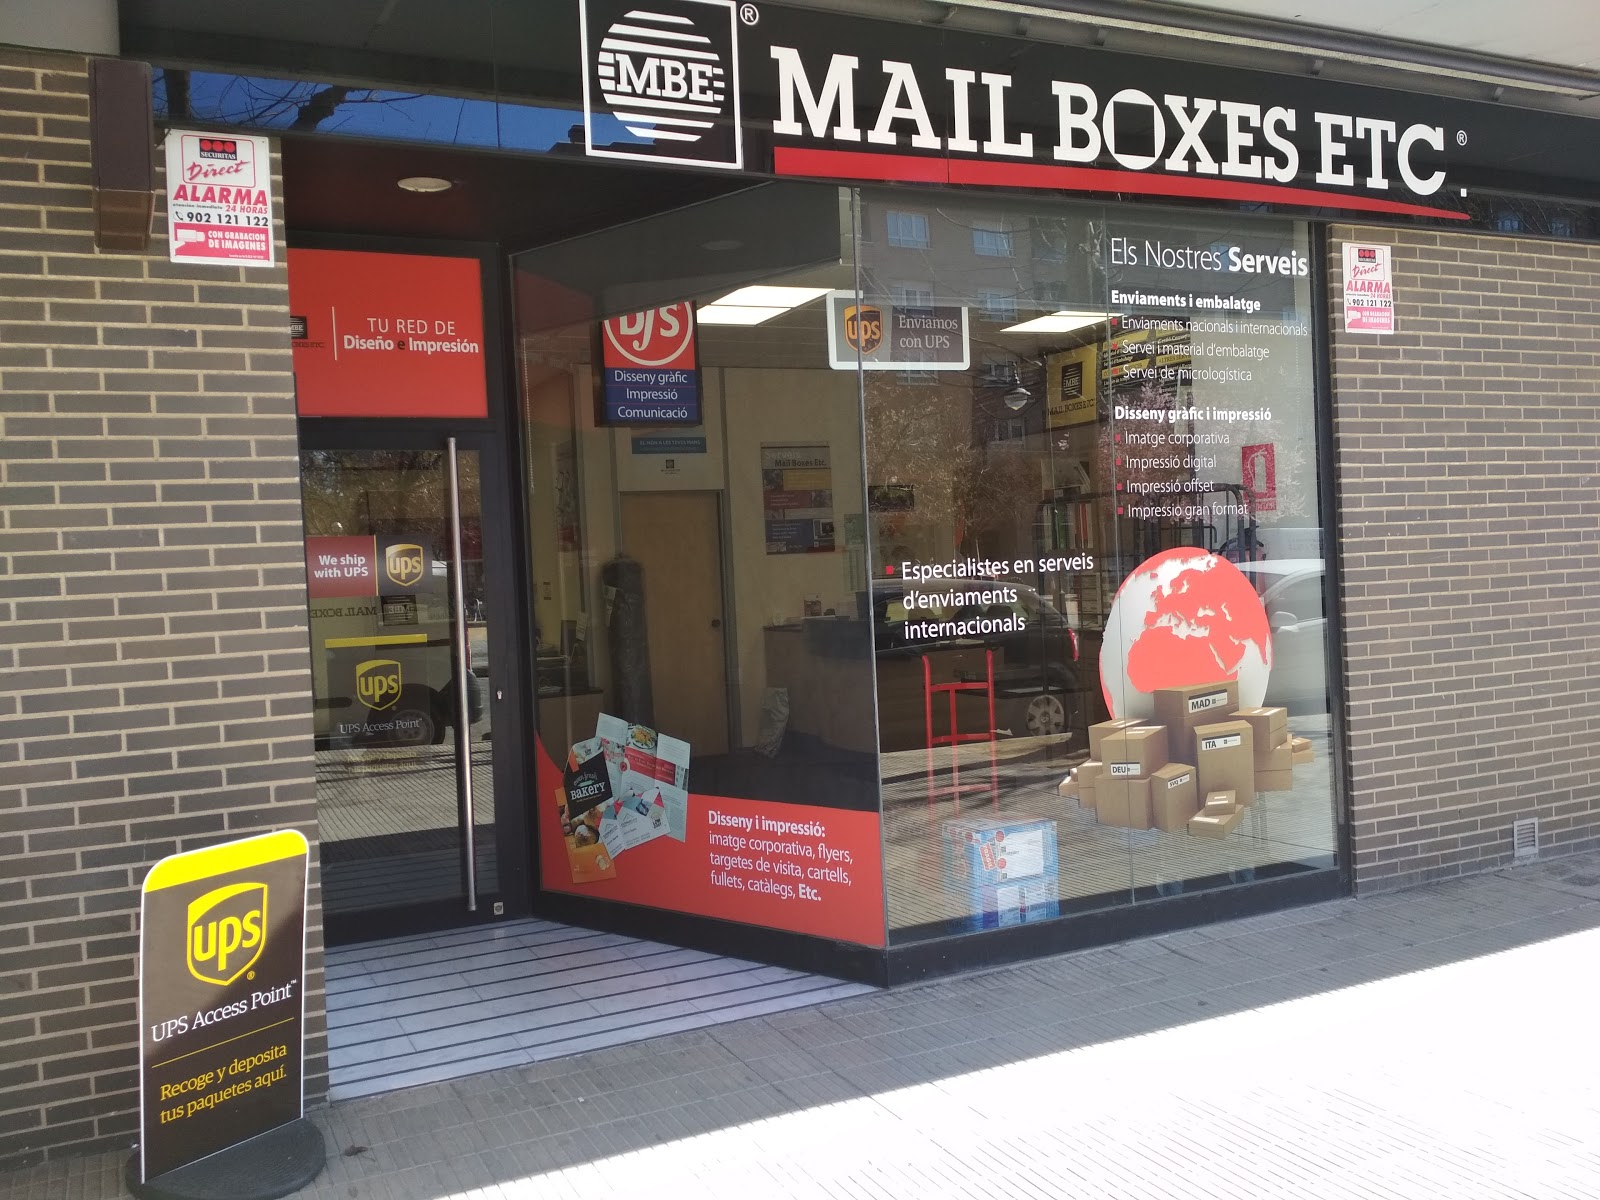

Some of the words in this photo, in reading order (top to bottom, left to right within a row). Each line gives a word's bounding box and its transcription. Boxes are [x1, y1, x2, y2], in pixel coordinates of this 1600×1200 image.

[615, 52, 715, 102] MBE
[770, 45, 1034, 157] MAIL
[1052, 80, 1299, 183] BOXES
[200, 151, 236, 160] SECURITAS
[187, 160, 250, 181] Direct
[173, 184, 268, 206] ALARMA
[226, 204, 236, 213] 24
[240, 206, 268, 214] HORAS
[187, 212, 211, 223] 902
[217, 214, 238, 224] 121
[246, 216, 268, 226] 122
[208, 230, 223, 239] CON
[224, 231, 266, 241] GRABACION
[208, 240, 220, 248] DE
[222, 240, 266, 250] IMAGENES
[1111, 237, 1138, 266] Els
[1145, 240, 1222, 272] Nostres
[1228, 246, 1308, 276] Serveis
[1352, 262, 1382, 278] Direct
[1346, 280, 1390, 293] ALARMA
[1112, 290, 1186, 307] Enviaments
[1189, 294, 1193, 307] i
[1196, 294, 1260, 314] embalatge
[367, 318, 388, 332] TU
[396, 319, 428, 334] RED
[434, 321, 456, 336] DE
[898, 315, 958, 330] Enviamos
[1122, 316, 1184, 332] Enviaments
[1185, 318, 1234, 334] nacionals
[1236, 320, 1238, 332] i
[1240, 321, 1308, 336] internacionals
[847, 320, 880, 348] ups
[900, 337, 921, 348] con
[924, 335, 950, 349] UPS
[343, 335, 394, 350] Diseño
[398, 340, 406, 350] e
[409, 337, 479, 354] Impresión
[1122, 340, 1155, 354] Servei
[1157, 342, 1161, 354] i
[1162, 342, 1204, 356] material
[1206, 343, 1270, 360] d'embalatge
[614, 370, 656, 384] Disseny
[658, 371, 688, 385] gràfic
[1066, 377, 1078, 388] MBE
[1123, 364, 1157, 379] Servei
[1160, 365, 1180, 379] de
[1183, 366, 1252, 383] micrologística
[626, 388, 678, 402] Impressió
[618, 406, 688, 418] Comunicació
[1115, 406, 1167, 423] Disseny
[1168, 406, 1204, 423] gràfic
[1206, 407, 1210, 420] i
[1212, 407, 1272, 423] impressió
[1125, 430, 1166, 448] Imatge
[1168, 432, 1230, 447] corporativa
[774, 459, 790, 467] Mail
[792, 459, 813, 467] Boxes
[814, 458, 826, 466] Etc.
[1126, 455, 1181, 470] Impressió
[1183, 454, 1217, 472] digital
[1126, 480, 1182, 495] Impressió
[1184, 478, 1214, 492] offset
[1185, 504, 1210, 518] gran
[1212, 502, 1248, 516] format
[318, 555, 337, 566] We
[340, 554, 366, 568] ship
[388, 555, 421, 580] ups
[902, 558, 1009, 583] Especialistes
[1014, 558, 1034, 574] en
[1038, 552, 1094, 572] serveis
[314, 567, 342, 578] with
[344, 566, 368, 578] UPS
[904, 612, 1026, 640] internacionals
[359, 674, 399, 702] ups
[1192, 698, 1210, 710] MAD
[340, 724, 360, 734] UPS
[362, 721, 394, 733] Access
[1205, 740, 1216, 749] ITA
[1170, 780, 1178, 788] SVQ
[708, 810, 752, 832] Disseny
[756, 815, 759, 830] i
[762, 816, 826, 838] impressió:
[709, 830, 746, 850] imatge
[748, 838, 816, 860] corporativa,
[818, 842, 853, 864] flyers,
[710, 852, 753, 870] targetes
[756, 857, 770, 872] de
[773, 860, 804, 879] visita,
[808, 867, 852, 886] cartells,
[711, 870, 745, 891] fullets,
[748, 878, 796, 900] catàlegs,
[798, 883, 822, 901] Etc.
[194, 910, 261, 972] ups
[152, 1016, 188, 1042] UPS
[192, 999, 247, 1030] Access
[160, 1069, 214, 1101] Recoge
[216, 1066, 226, 1082] y
[228, 1044, 288, 1078] deposita
[160, 1106, 184, 1124] tus
[187, 1080, 252, 1118] paquetes
[254, 1064, 288, 1092] aquí.
